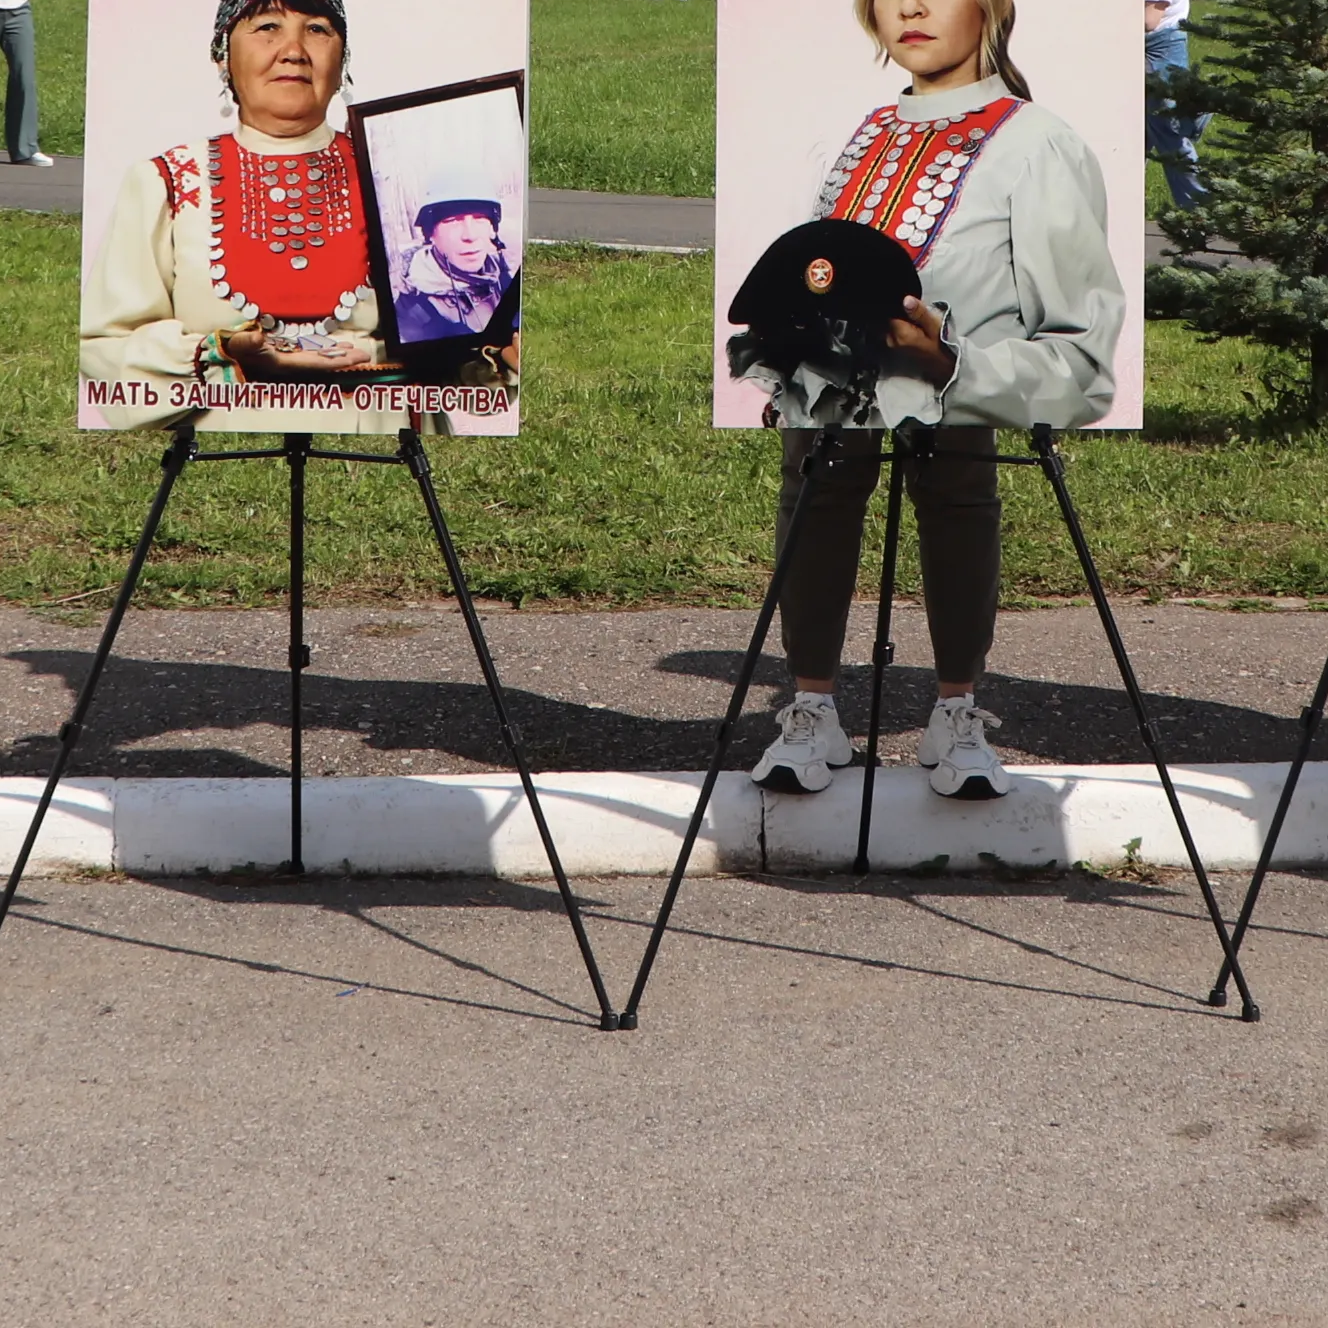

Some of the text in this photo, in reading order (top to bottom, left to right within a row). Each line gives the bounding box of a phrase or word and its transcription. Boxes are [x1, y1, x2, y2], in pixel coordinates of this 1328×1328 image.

[86, 380, 510, 414] МАТЬ ЗАЩИТНИКА ОТЕЧЕСТВА
